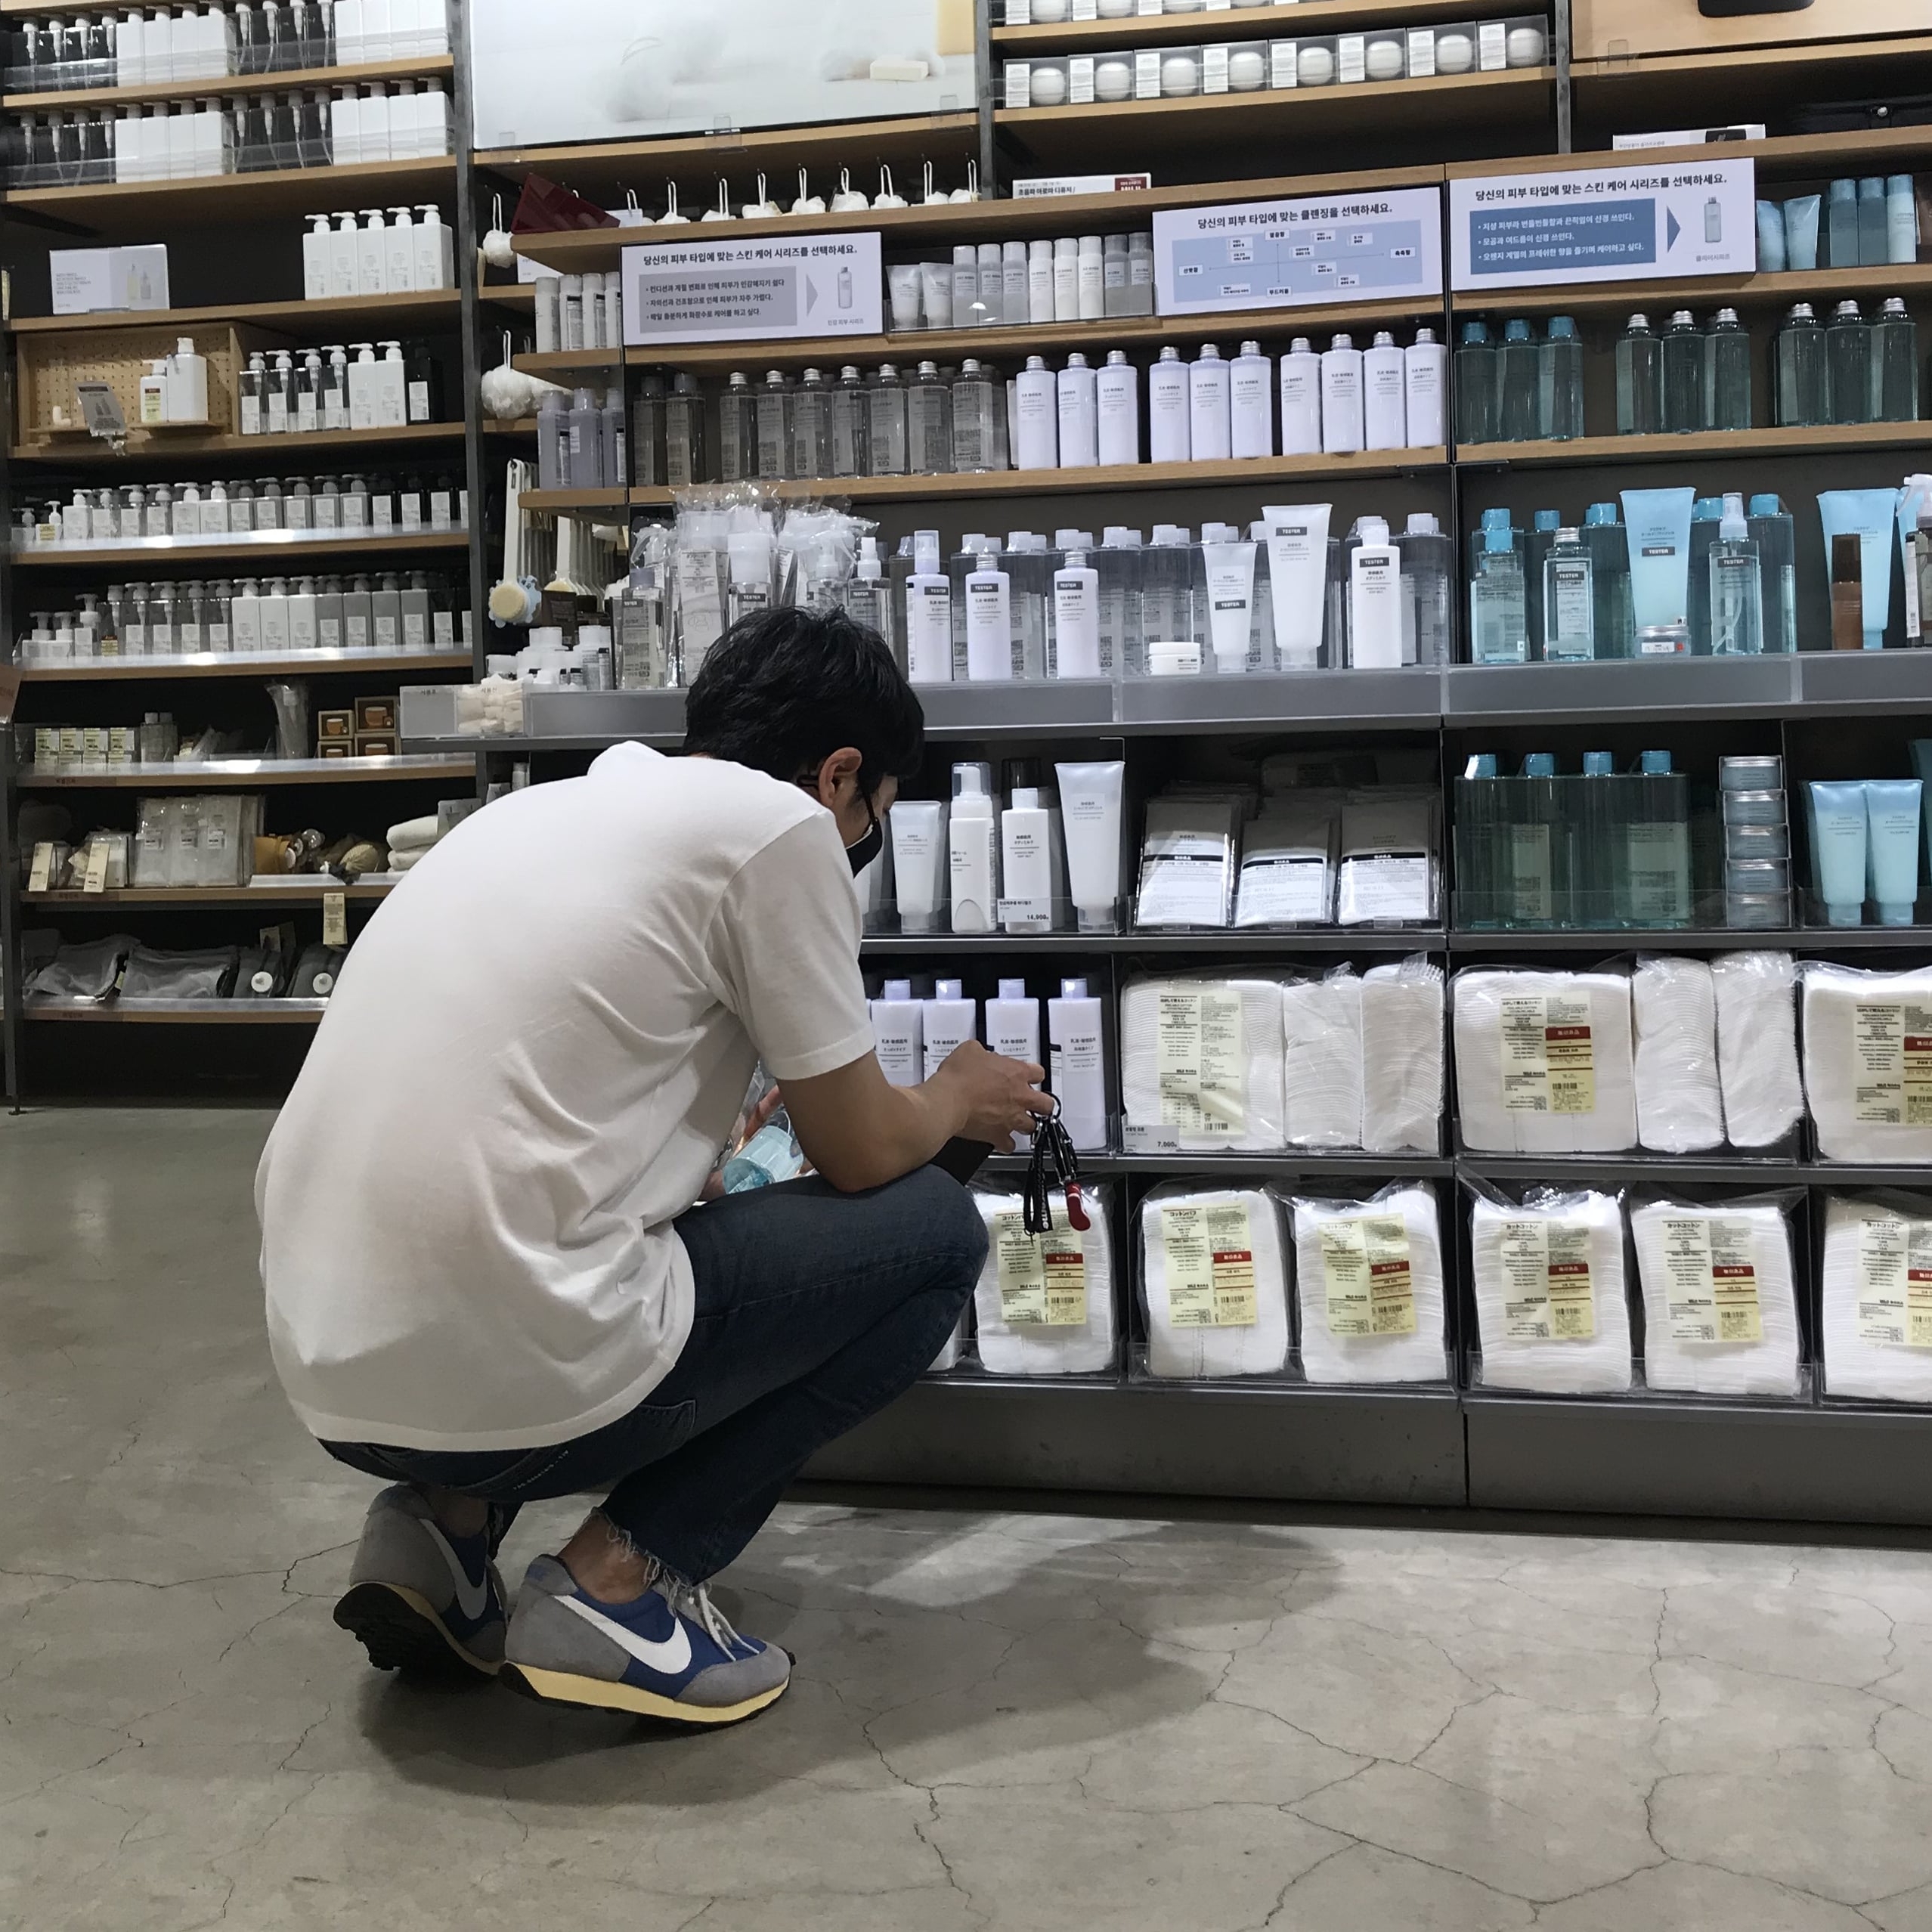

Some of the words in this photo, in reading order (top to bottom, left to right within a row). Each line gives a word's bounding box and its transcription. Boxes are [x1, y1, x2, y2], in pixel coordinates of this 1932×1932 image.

[1475, 189, 1504, 201] 당신의
[1507, 187, 1527, 199] 피부
[1530, 184, 1559, 197] 타입에
[1562, 183, 1582, 195] 맞는
[1584, 181, 1604, 193] 스킨
[1607, 180, 1626, 191] 케어
[1630, 177, 1670, 190] 시리즈를
[1673, 173, 1727, 187] 선택하세요.
[1198, 217, 1225, 229] 당신의
[1228, 215, 1246, 227] 피부
[1249, 212, 1277, 224] 타입에
[1280, 211, 1299, 222] 맞는
[1302, 208, 1338, 221] 클렌징을
[1341, 203, 1392, 217] 선택하세요.
[643, 254, 668, 265] 당신의
[671, 254, 687, 264] 피부
[690, 252, 714, 262] 타입에
[717, 251, 734, 262] 맞는
[736, 250, 753, 260] 스킨
[755, 249, 772, 259] 케어
[775, 246, 808, 258] 시리즈를
[811, 244, 857, 256] 선택하세요.
